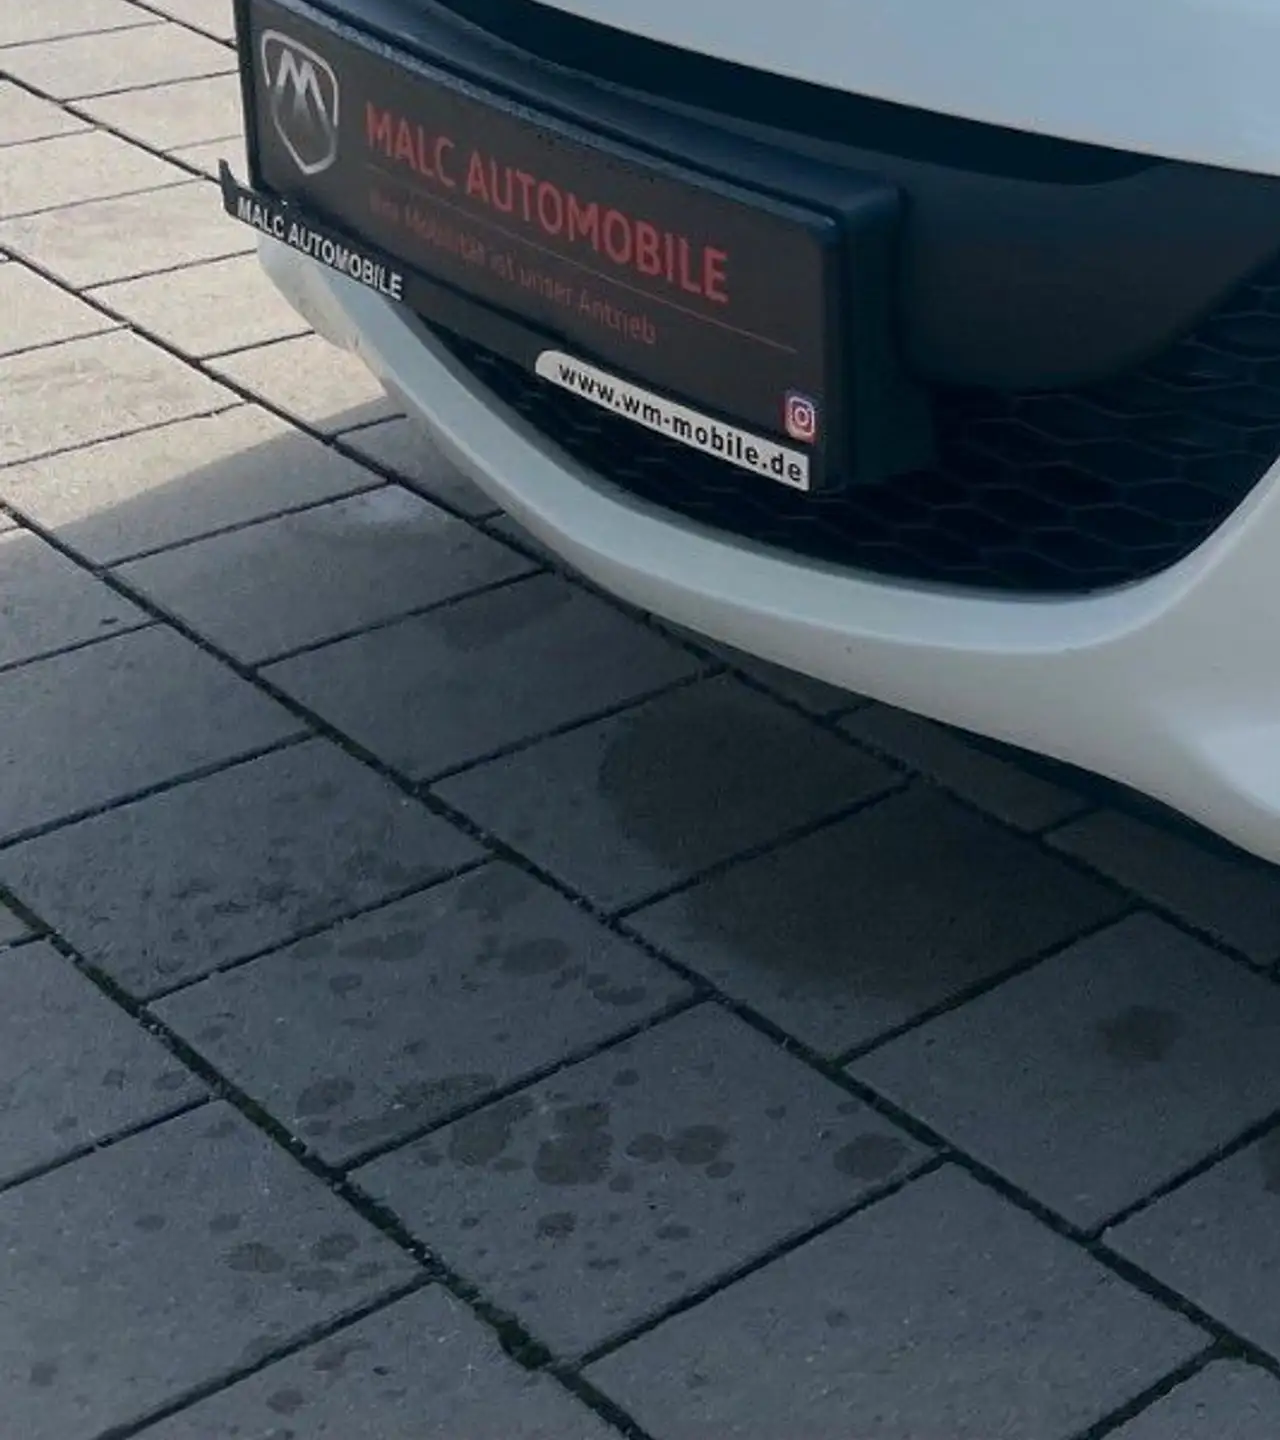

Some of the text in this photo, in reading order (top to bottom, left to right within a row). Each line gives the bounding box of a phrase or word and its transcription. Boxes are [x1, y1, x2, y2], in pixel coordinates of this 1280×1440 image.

[237, 196, 402, 301] MALC AUTOMOBILE
[366, 100, 730, 303] MALC AUTOMOBILE
[557, 363, 801, 482] www.wm-mobile.de
